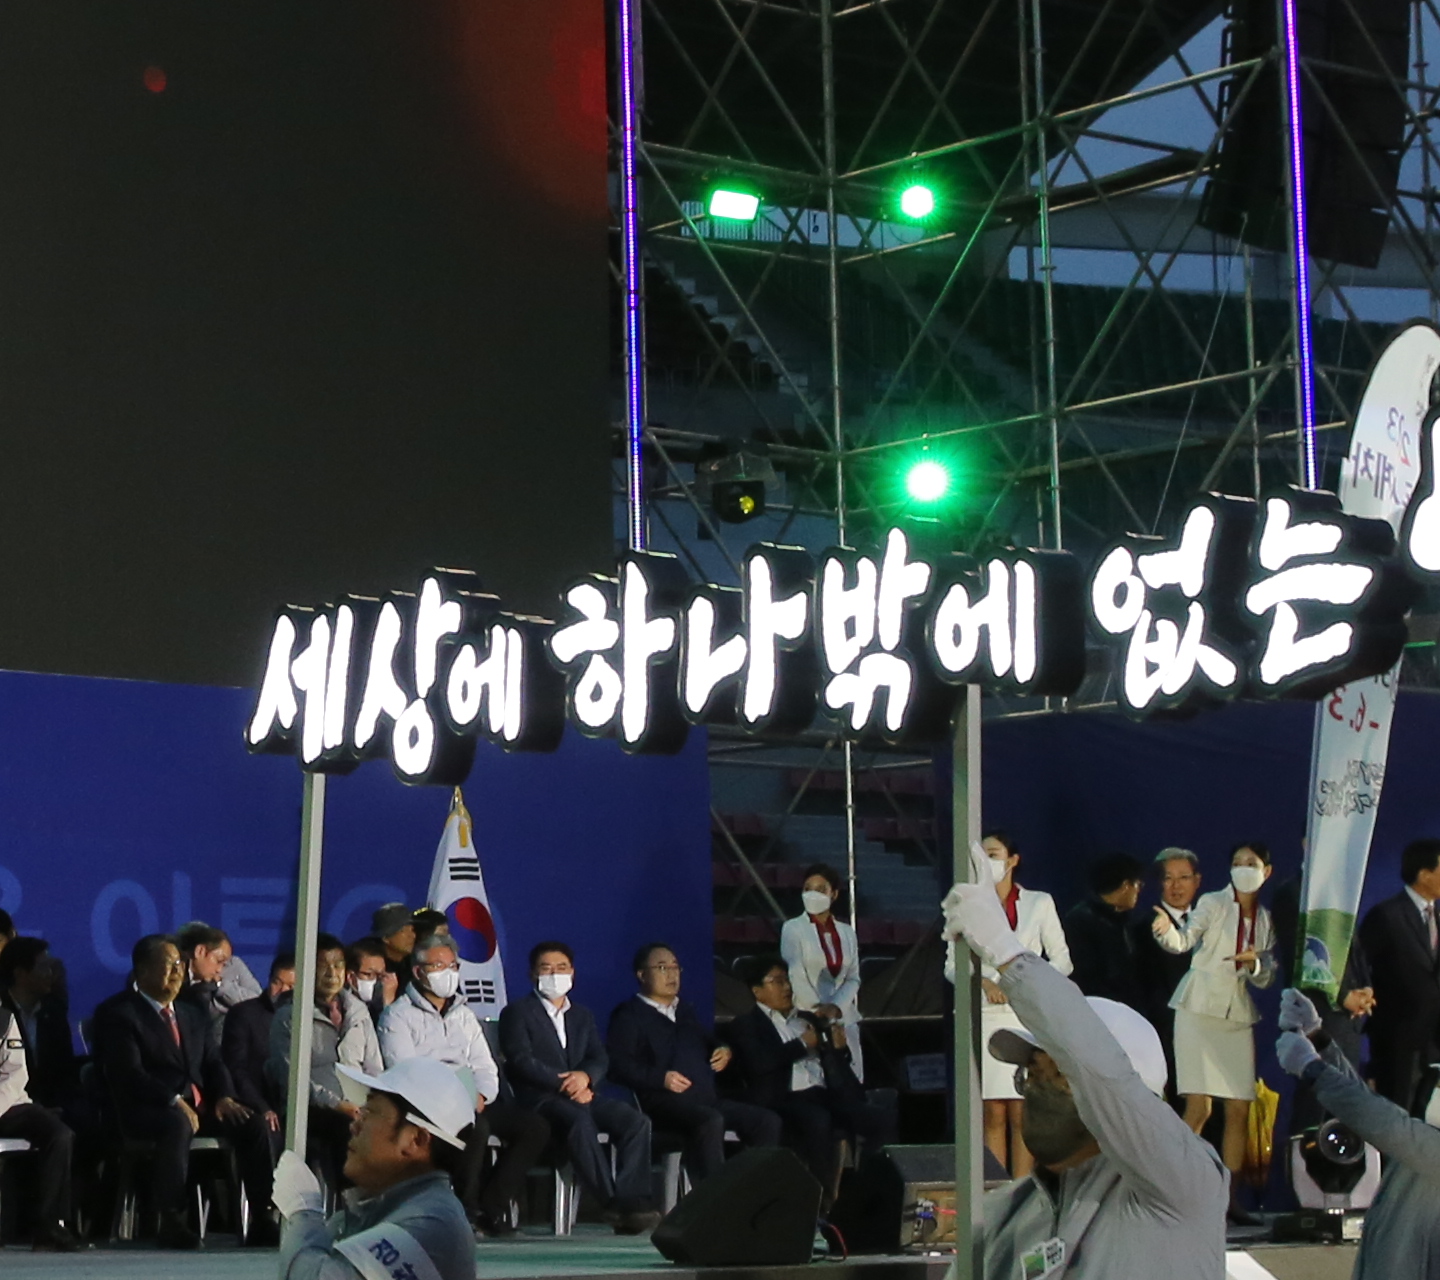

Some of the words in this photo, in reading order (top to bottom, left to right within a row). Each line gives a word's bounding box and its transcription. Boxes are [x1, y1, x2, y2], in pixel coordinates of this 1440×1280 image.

[250, 577, 523, 776] 세상에
[551, 527, 1037, 744] 하나밖에
[1092, 498, 1373, 710] 없는
